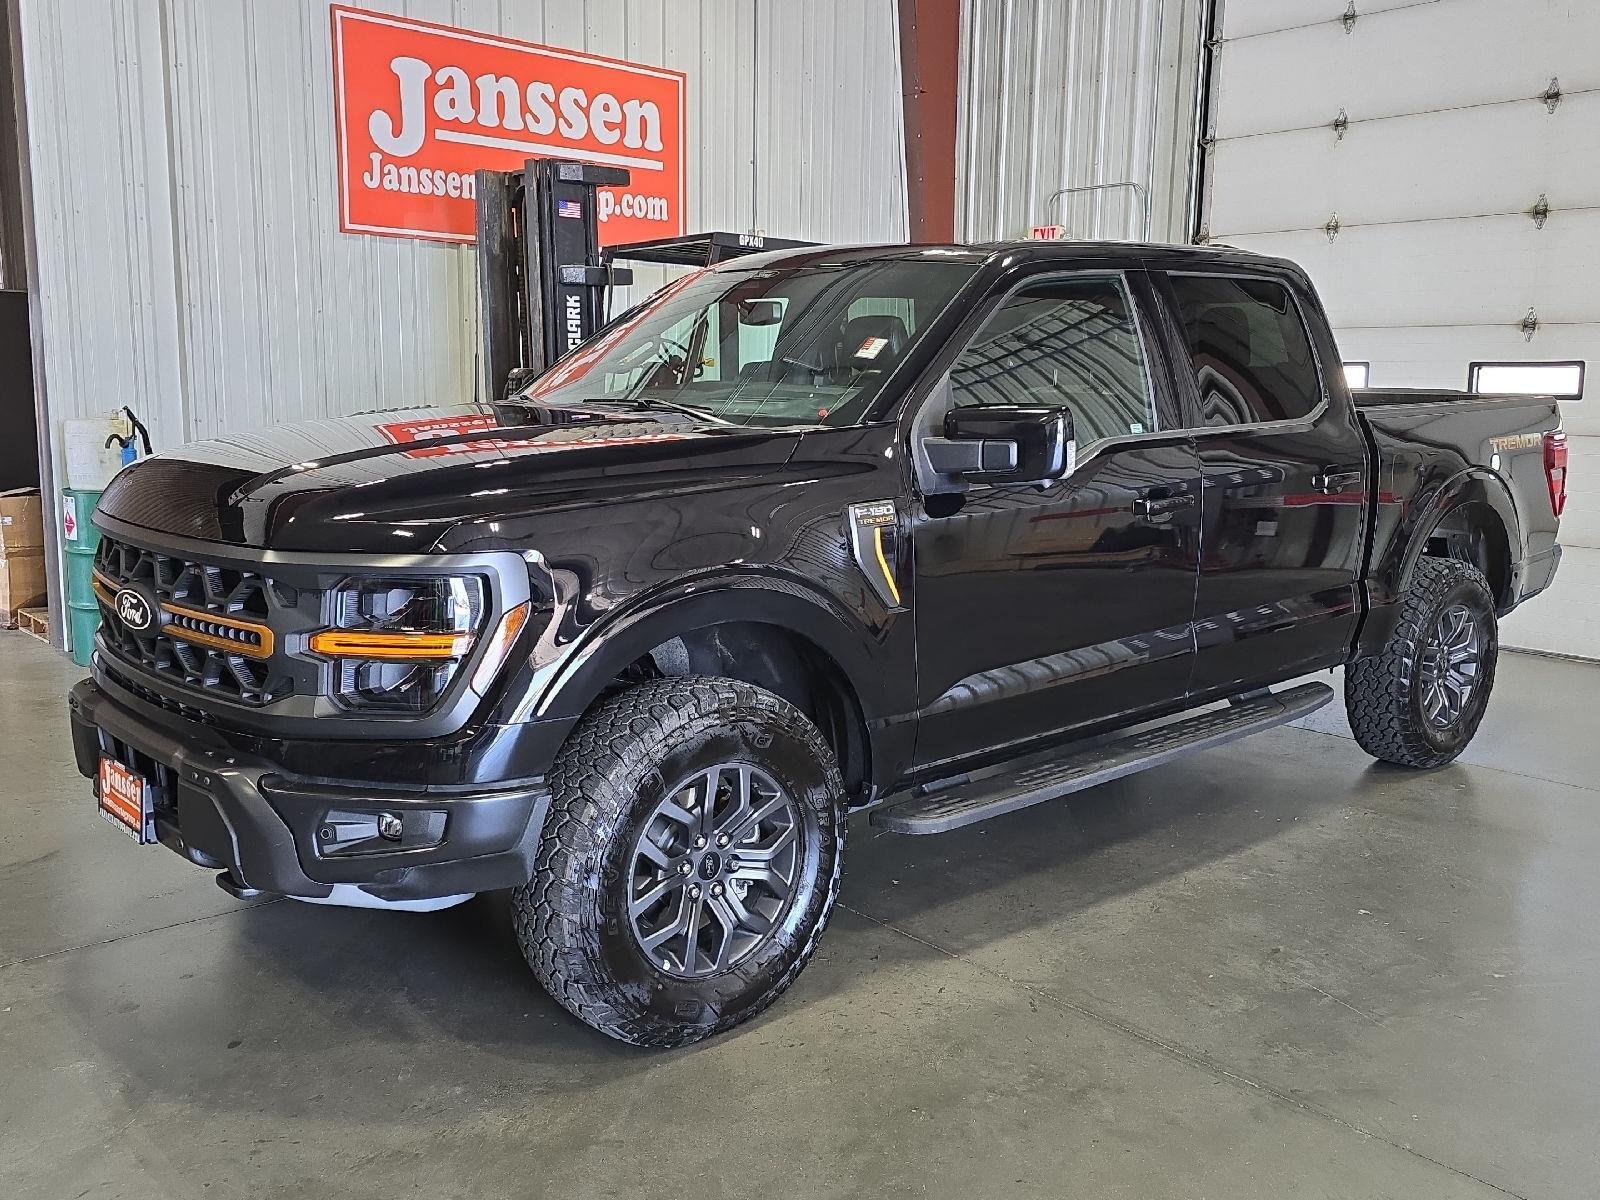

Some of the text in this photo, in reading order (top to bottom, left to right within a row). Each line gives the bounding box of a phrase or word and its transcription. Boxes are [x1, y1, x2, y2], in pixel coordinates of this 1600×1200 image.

[368, 56, 664, 157] Janssen
[739, 234, 764, 248] GPX40
[566, 294, 583, 350] CLARK
[1489, 432, 1542, 451] TREMOR
[855, 504, 894, 518] F-150
[858, 515, 894, 525] TREMOR
[120, 594, 144, 625] Ford
